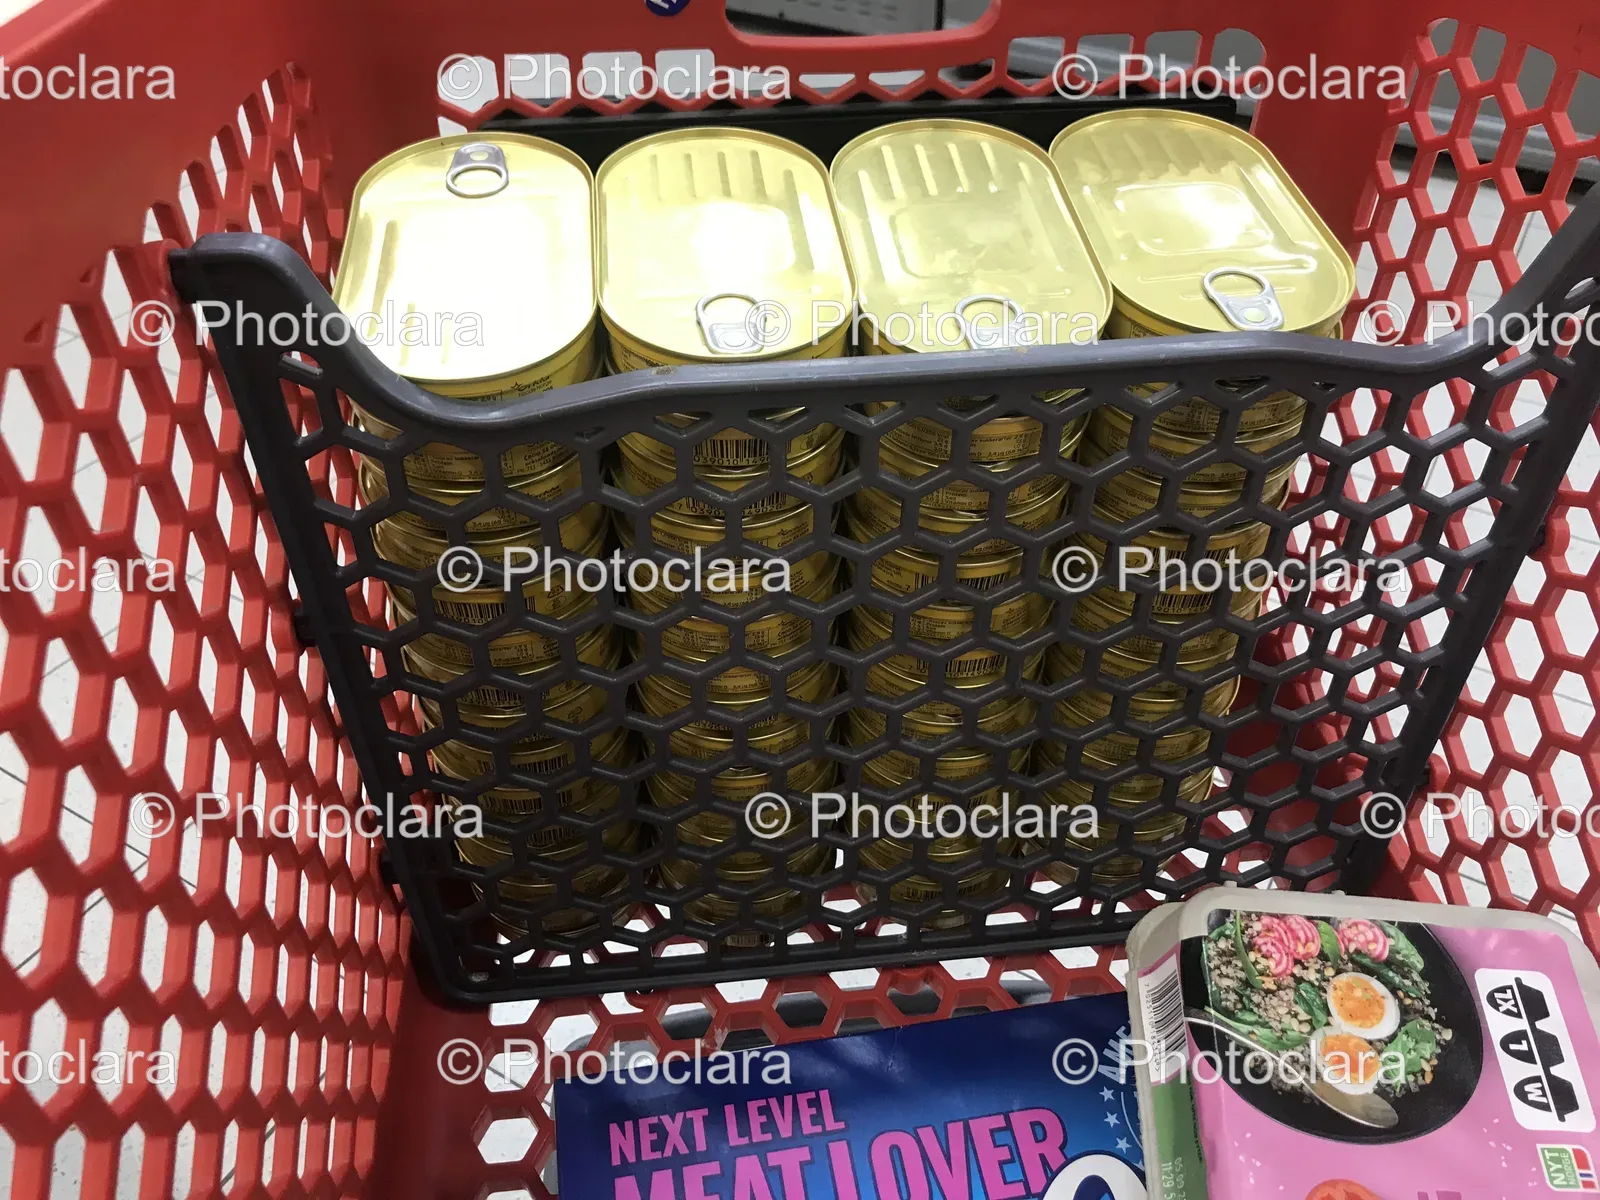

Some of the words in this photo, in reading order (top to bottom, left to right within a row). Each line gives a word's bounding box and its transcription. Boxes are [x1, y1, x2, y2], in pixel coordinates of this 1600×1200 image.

[1493, 988, 1518, 1013] XL
[1523, 1082, 1548, 1104] M
[608, 1107, 708, 1167] NEXT
[723, 1089, 846, 1147] LEVEL
[1544, 1149, 1568, 1185] NYT
[1560, 1152, 1577, 1185] NORGE
